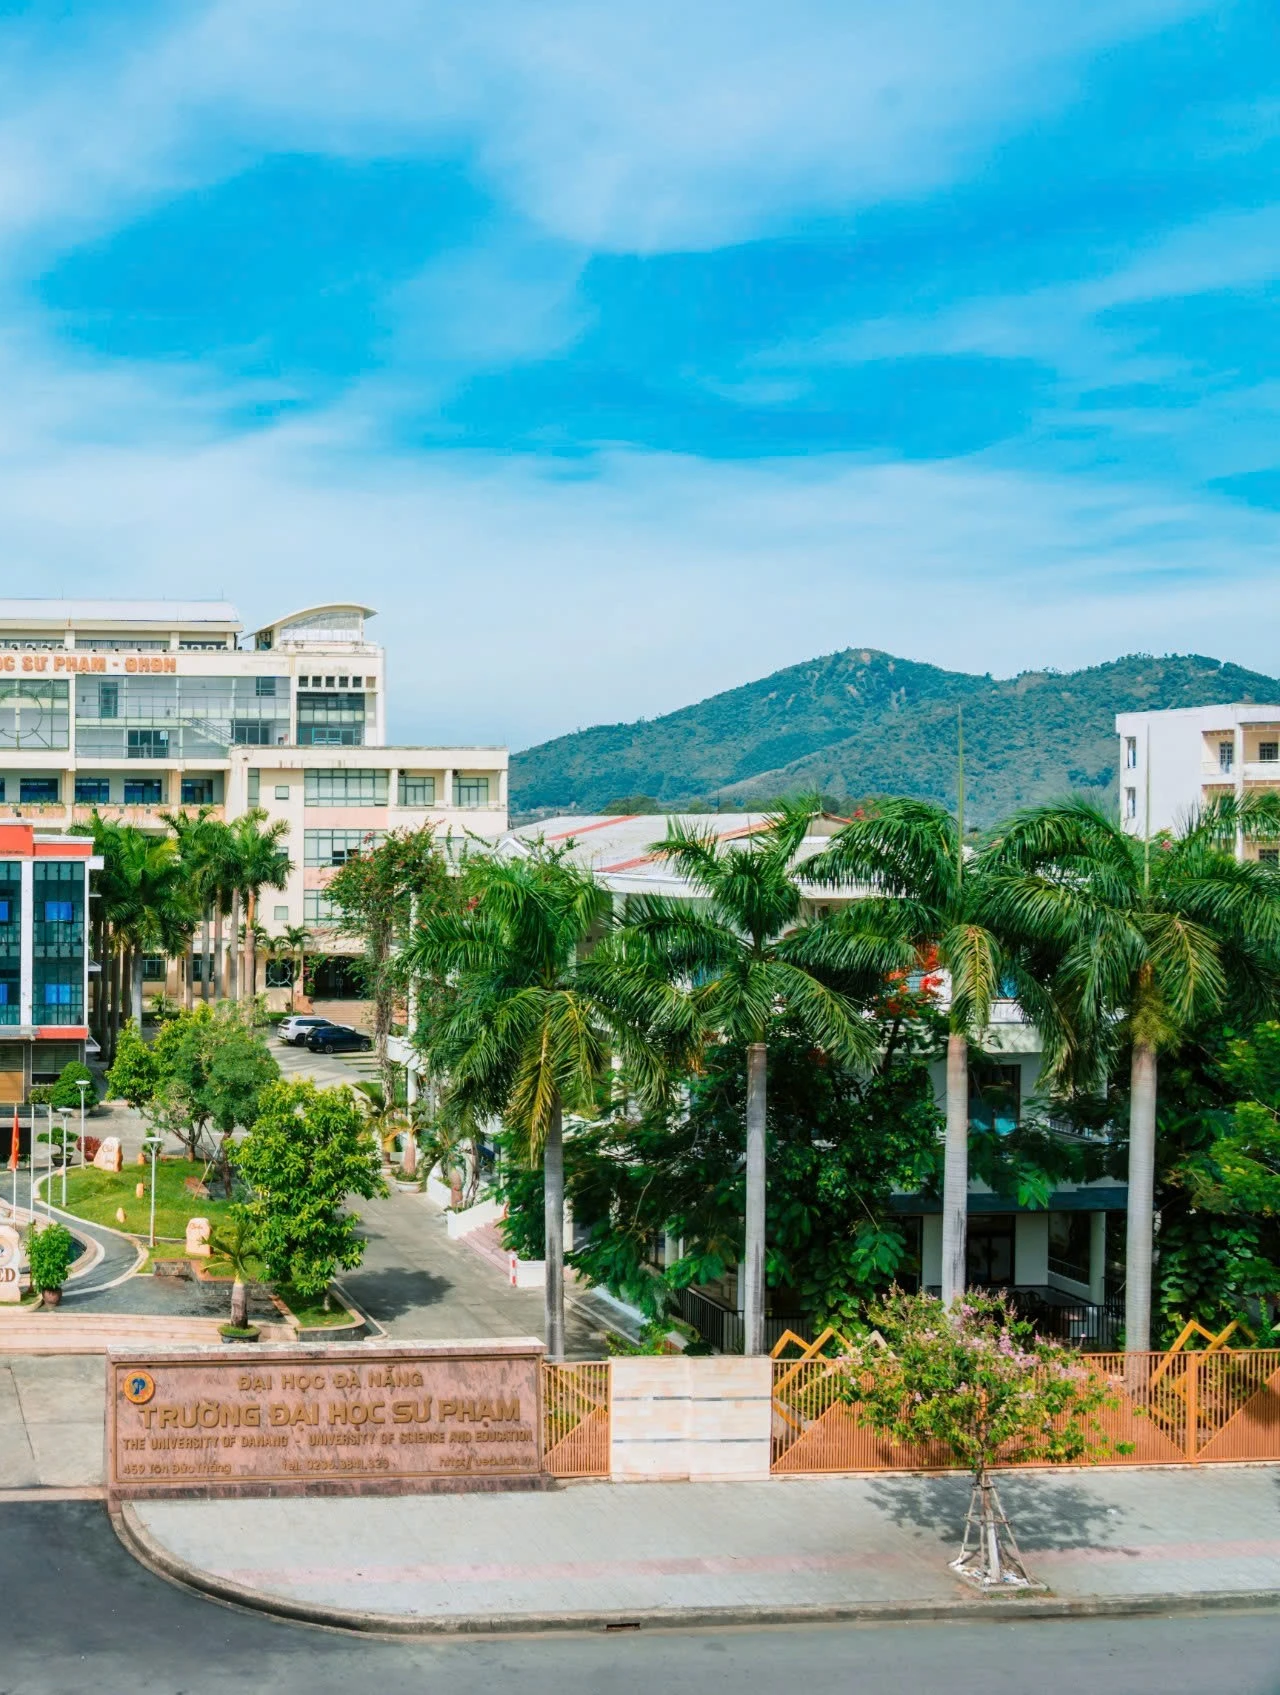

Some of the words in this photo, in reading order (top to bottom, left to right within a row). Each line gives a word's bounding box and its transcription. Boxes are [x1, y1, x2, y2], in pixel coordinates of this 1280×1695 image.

[22, 655, 48, 672] SƯ
[237, 1374, 273, 1393] ĐẠI
[281, 1373, 326, 1393] HỌC
[333, 1367, 361, 1389] ĐÀ
[369, 1365, 424, 1388] NẴNG
[139, 1400, 261, 1430] TRƯỜNG
[270, 1402, 320, 1432] ĐẠI
[328, 1400, 385, 1432] HỌC
[392, 1396, 433, 1424] SƯ
[437, 1398, 520, 1428] PHẠM
[123, 1438, 146, 1450] THE
[150, 1436, 219, 1450] UNIVERSITY
[223, 1436, 236, 1448] OF
[241, 1435, 289, 1448] DANANG
[309, 1432, 376, 1447] UNIVERSITY
[381, 1432, 395, 1445] OF
[400, 1431, 445, 1445] SCIENCE
[449, 1430, 472, 1443] AND
[475, 1429, 533, 1443] EDUCATION
